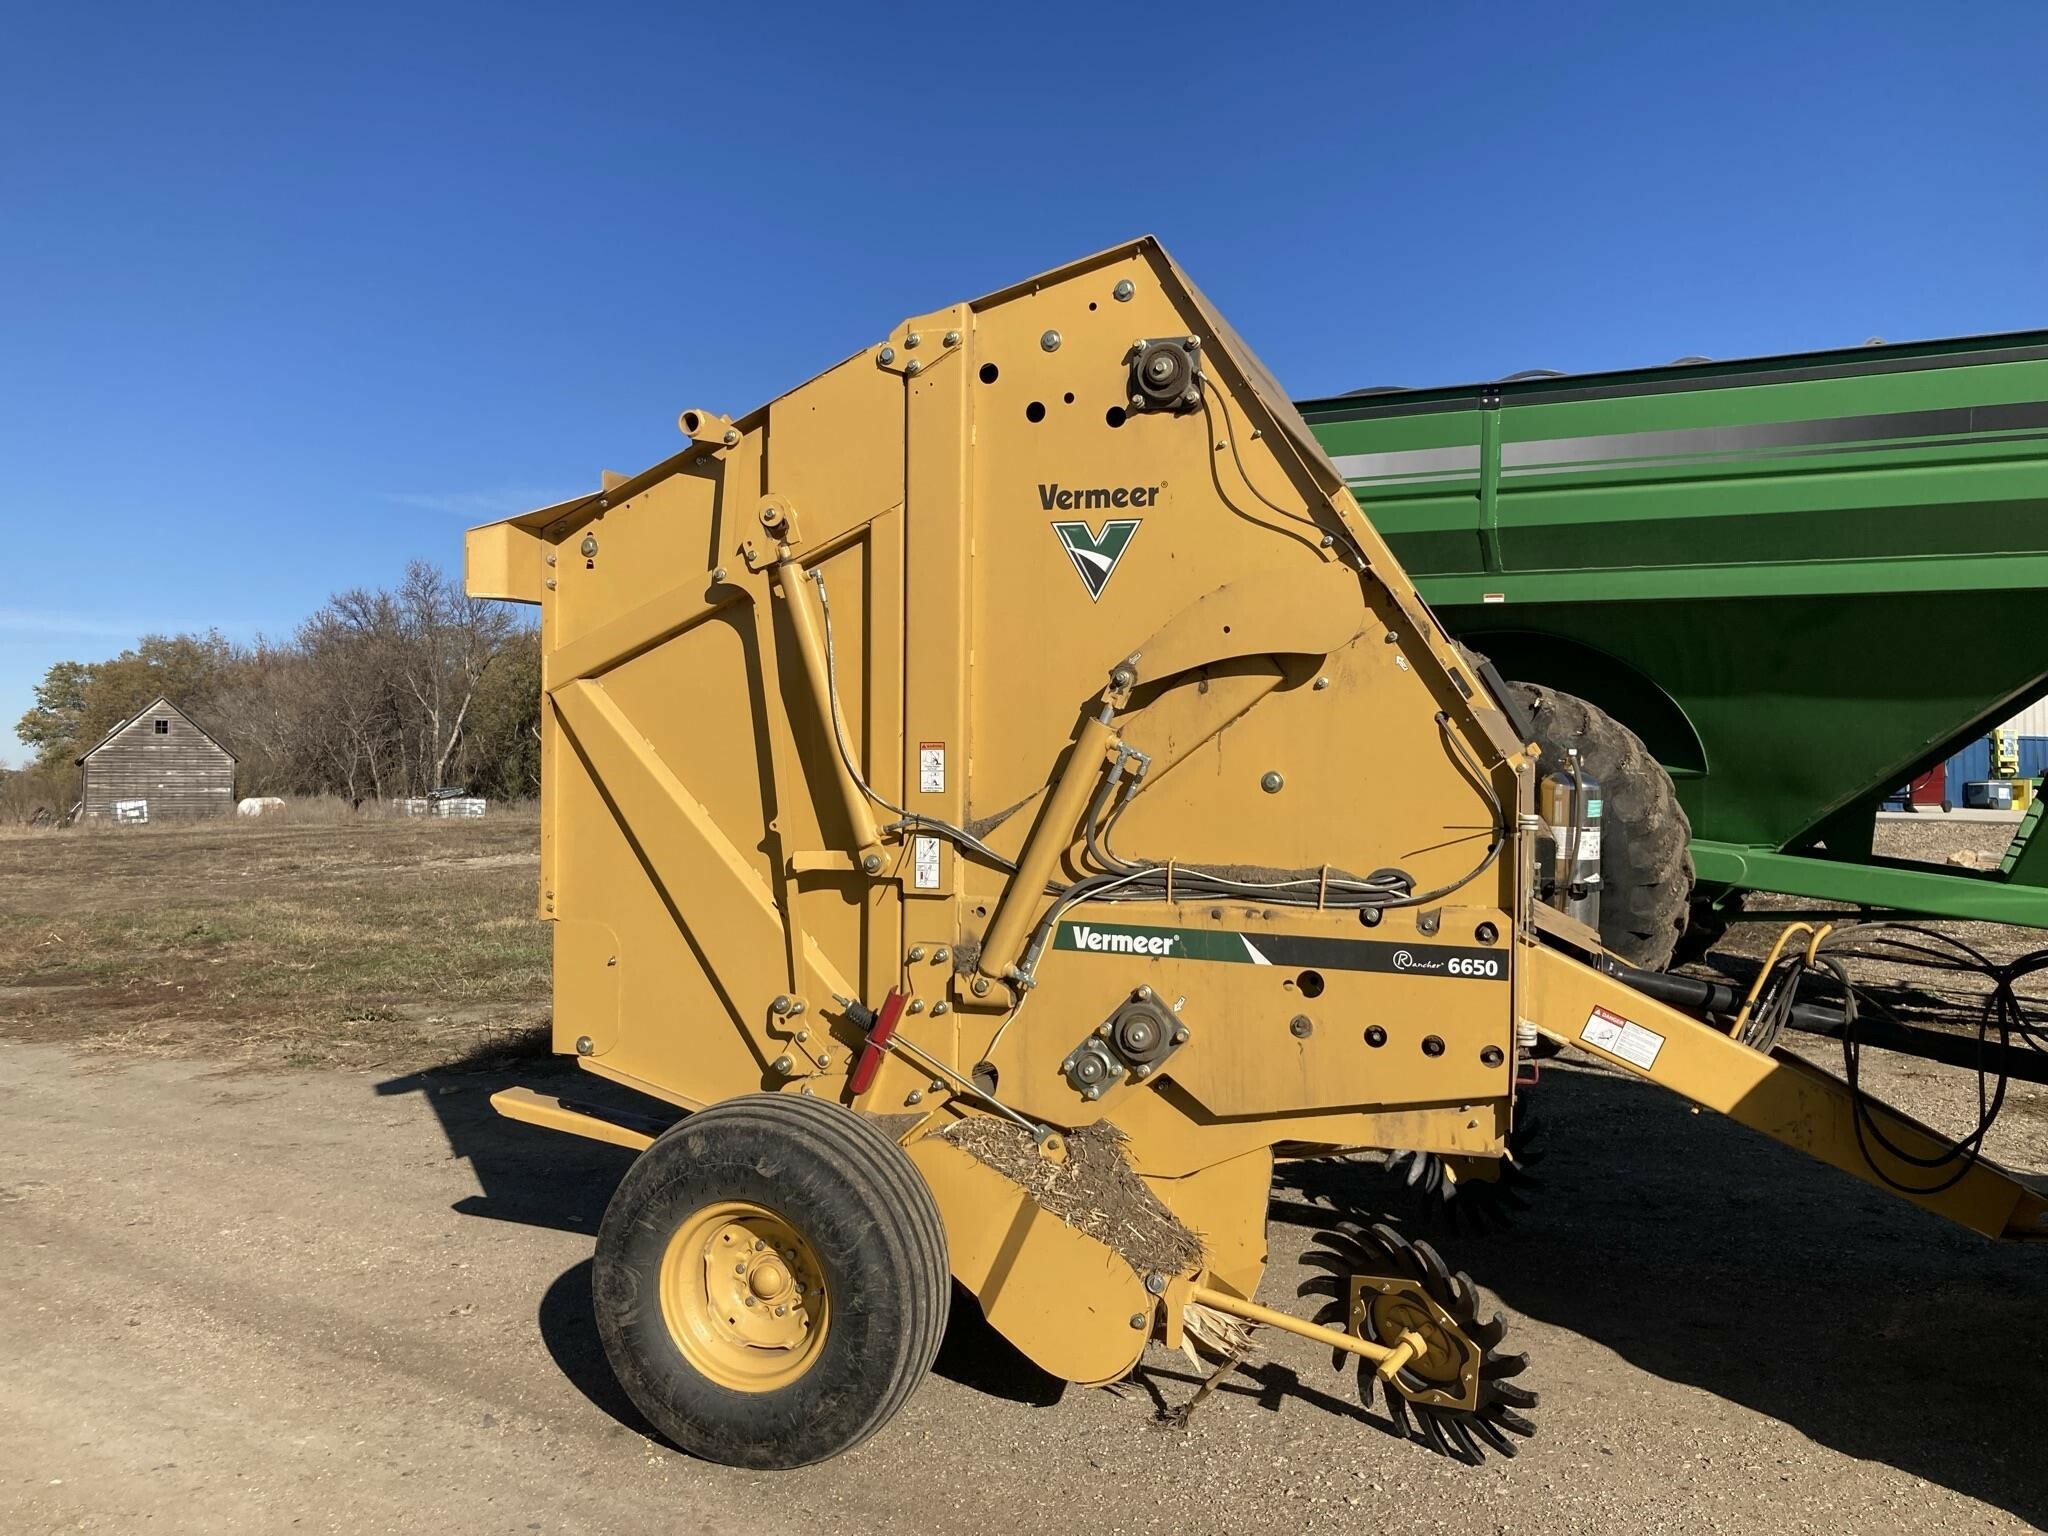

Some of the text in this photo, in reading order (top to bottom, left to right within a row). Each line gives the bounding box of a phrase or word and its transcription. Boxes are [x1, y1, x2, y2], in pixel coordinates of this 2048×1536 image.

[1038, 484, 1159, 510] Vermeer
[1072, 926, 1173, 955] Vermeer
[1447, 957, 1498, 977] 6650
